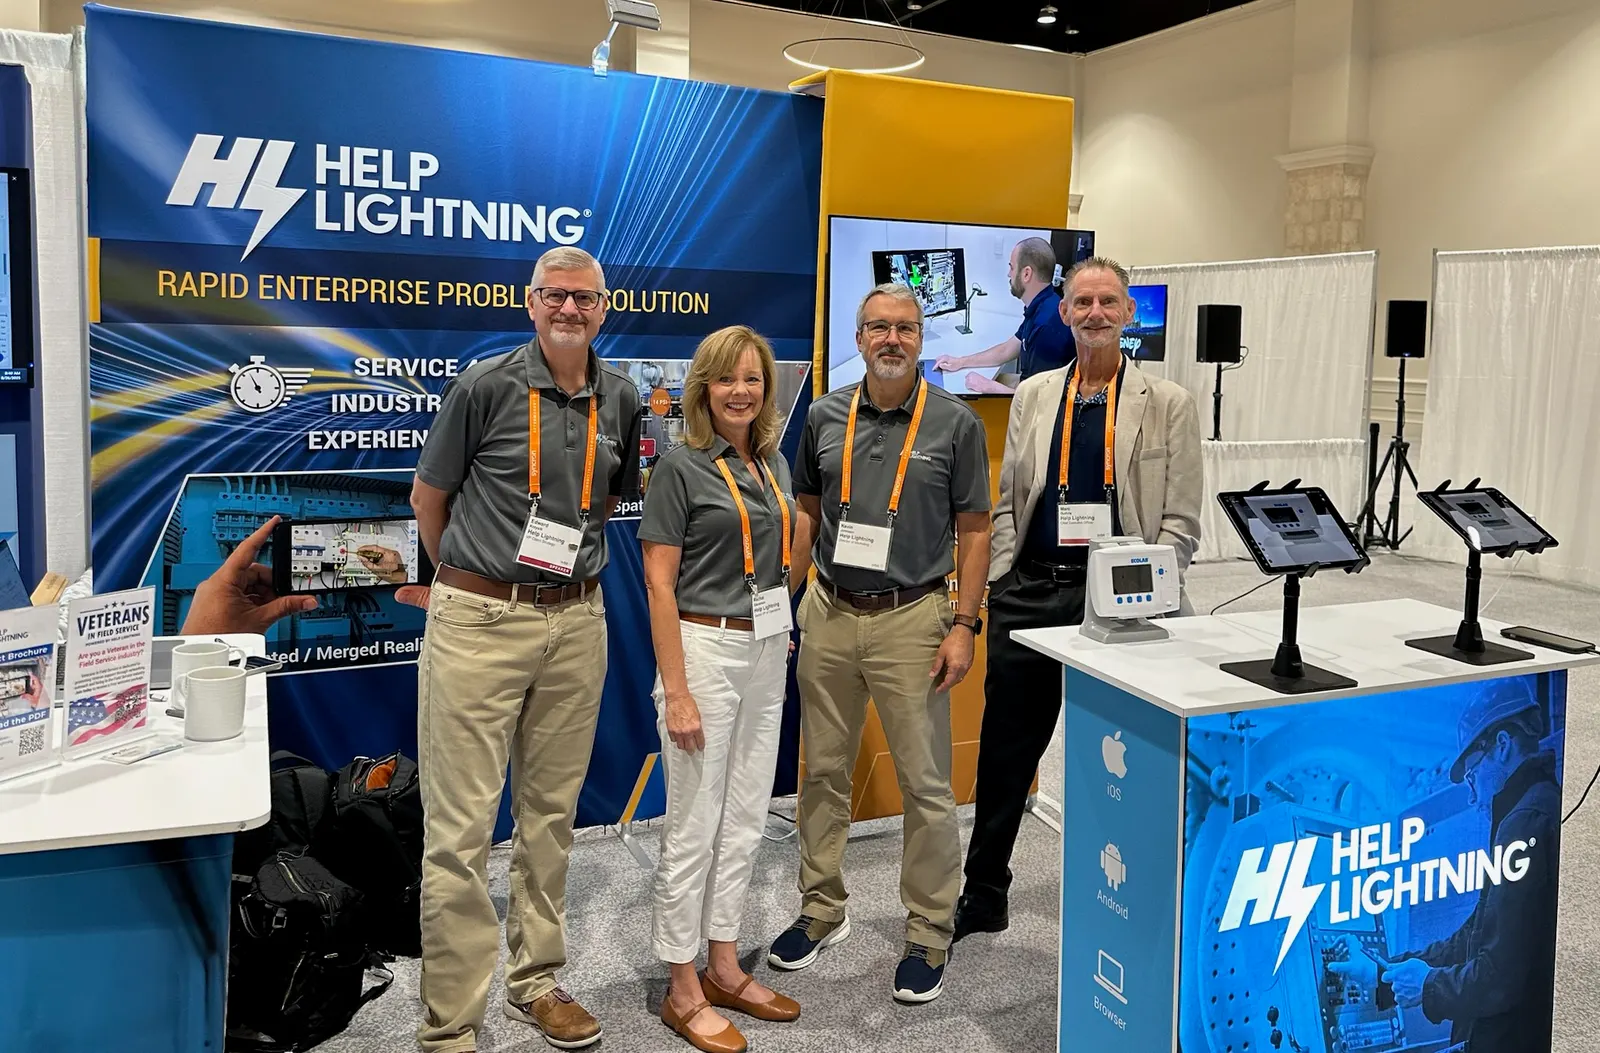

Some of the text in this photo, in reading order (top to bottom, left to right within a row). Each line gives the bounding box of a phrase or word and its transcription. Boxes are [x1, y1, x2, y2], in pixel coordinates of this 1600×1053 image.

[315, 143, 440, 191] HELP
[157, 269, 249, 299] RAPID
[258, 274, 430, 306] ENTERPRISE
[438, 281, 531, 310] PROBL
[354, 357, 459, 378] SERVICE
[331, 393, 442, 413] INDUSTR
[308, 429, 428, 450] EXPERIEN
[613, 499, 644, 515] Spat
[527, 529, 540, 537] Help
[540, 532, 565, 545] Lightning
[851, 535, 874, 544] Lightning
[549, 564, 570, 574] SPEAKER
[77, 604, 150, 637] VETERANS
[87, 624, 140, 640] IN FIELD SERVICE
[8, 647, 48, 660] Brochure
[78, 652, 89, 660] Are
[89, 650, 101, 659] you
[106, 645, 129, 654] Veteran
[316, 641, 379, 661] Merged
[384, 637, 424, 655] Reali
[78, 660, 95, 669] Field
[95, 655, 117, 665] Service
[11, 716, 27, 726] the
[28, 710, 47, 721] PDF
[1106, 782, 1122, 801] iOS
[1331, 816, 1425, 876] HELP
[1096, 888, 1129, 921] Android
[1093, 995, 1127, 1031] Browser
